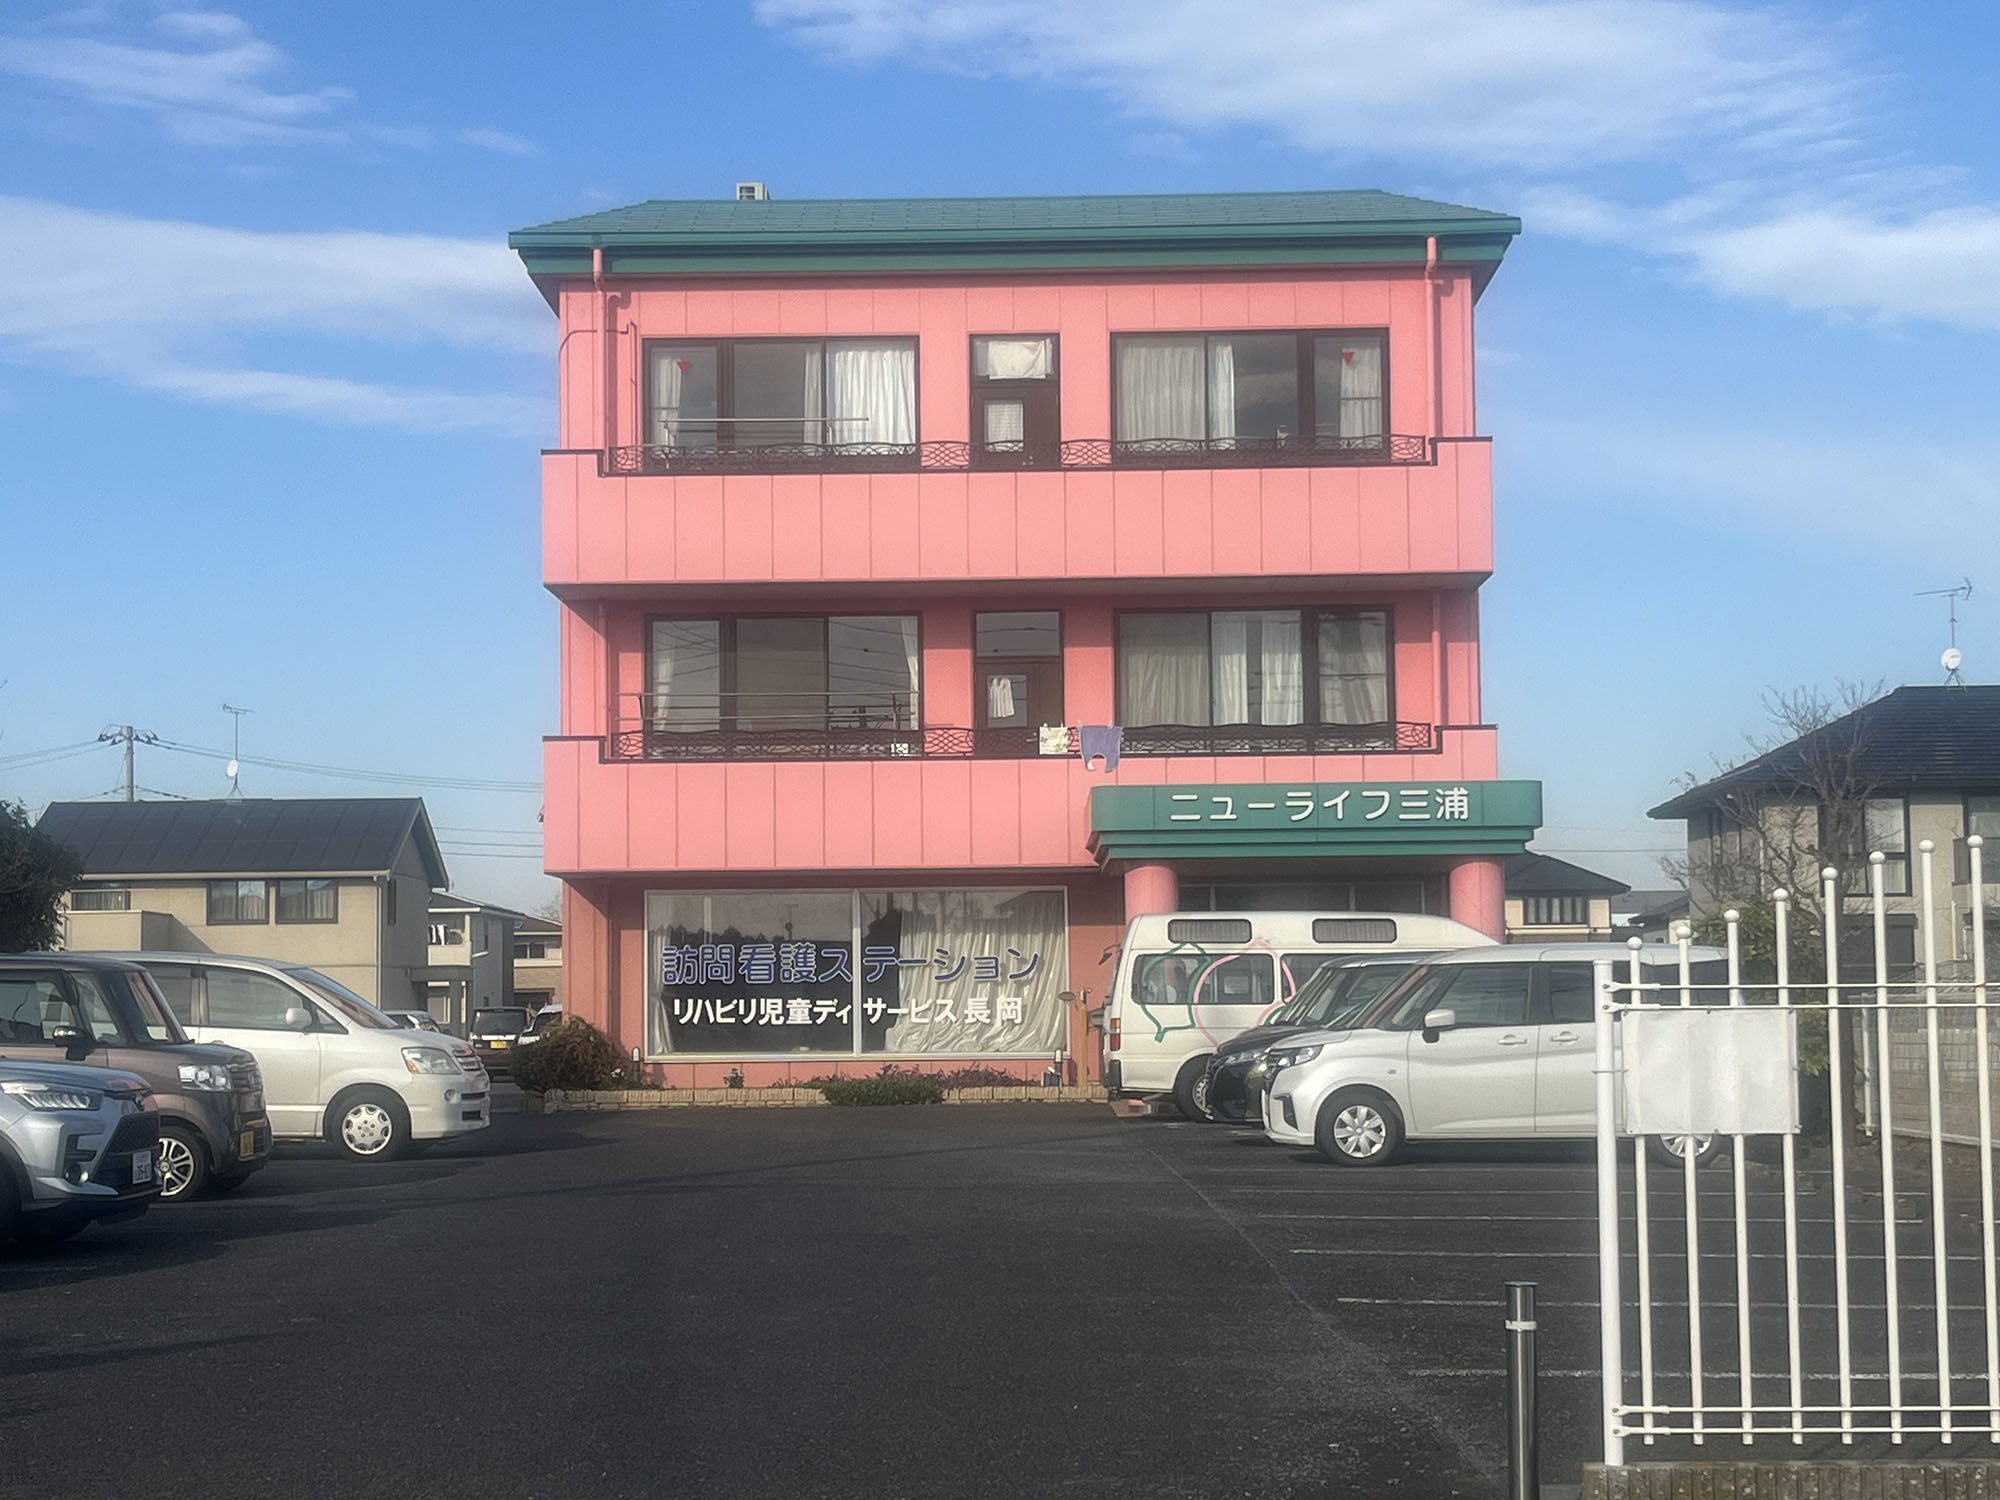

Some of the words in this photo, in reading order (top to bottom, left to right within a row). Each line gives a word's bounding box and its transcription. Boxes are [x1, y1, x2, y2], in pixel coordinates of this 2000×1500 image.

[1170, 787, 1469, 821] ニューライフ三浦
[662, 942, 1040, 984] 訪問看護ステーション
